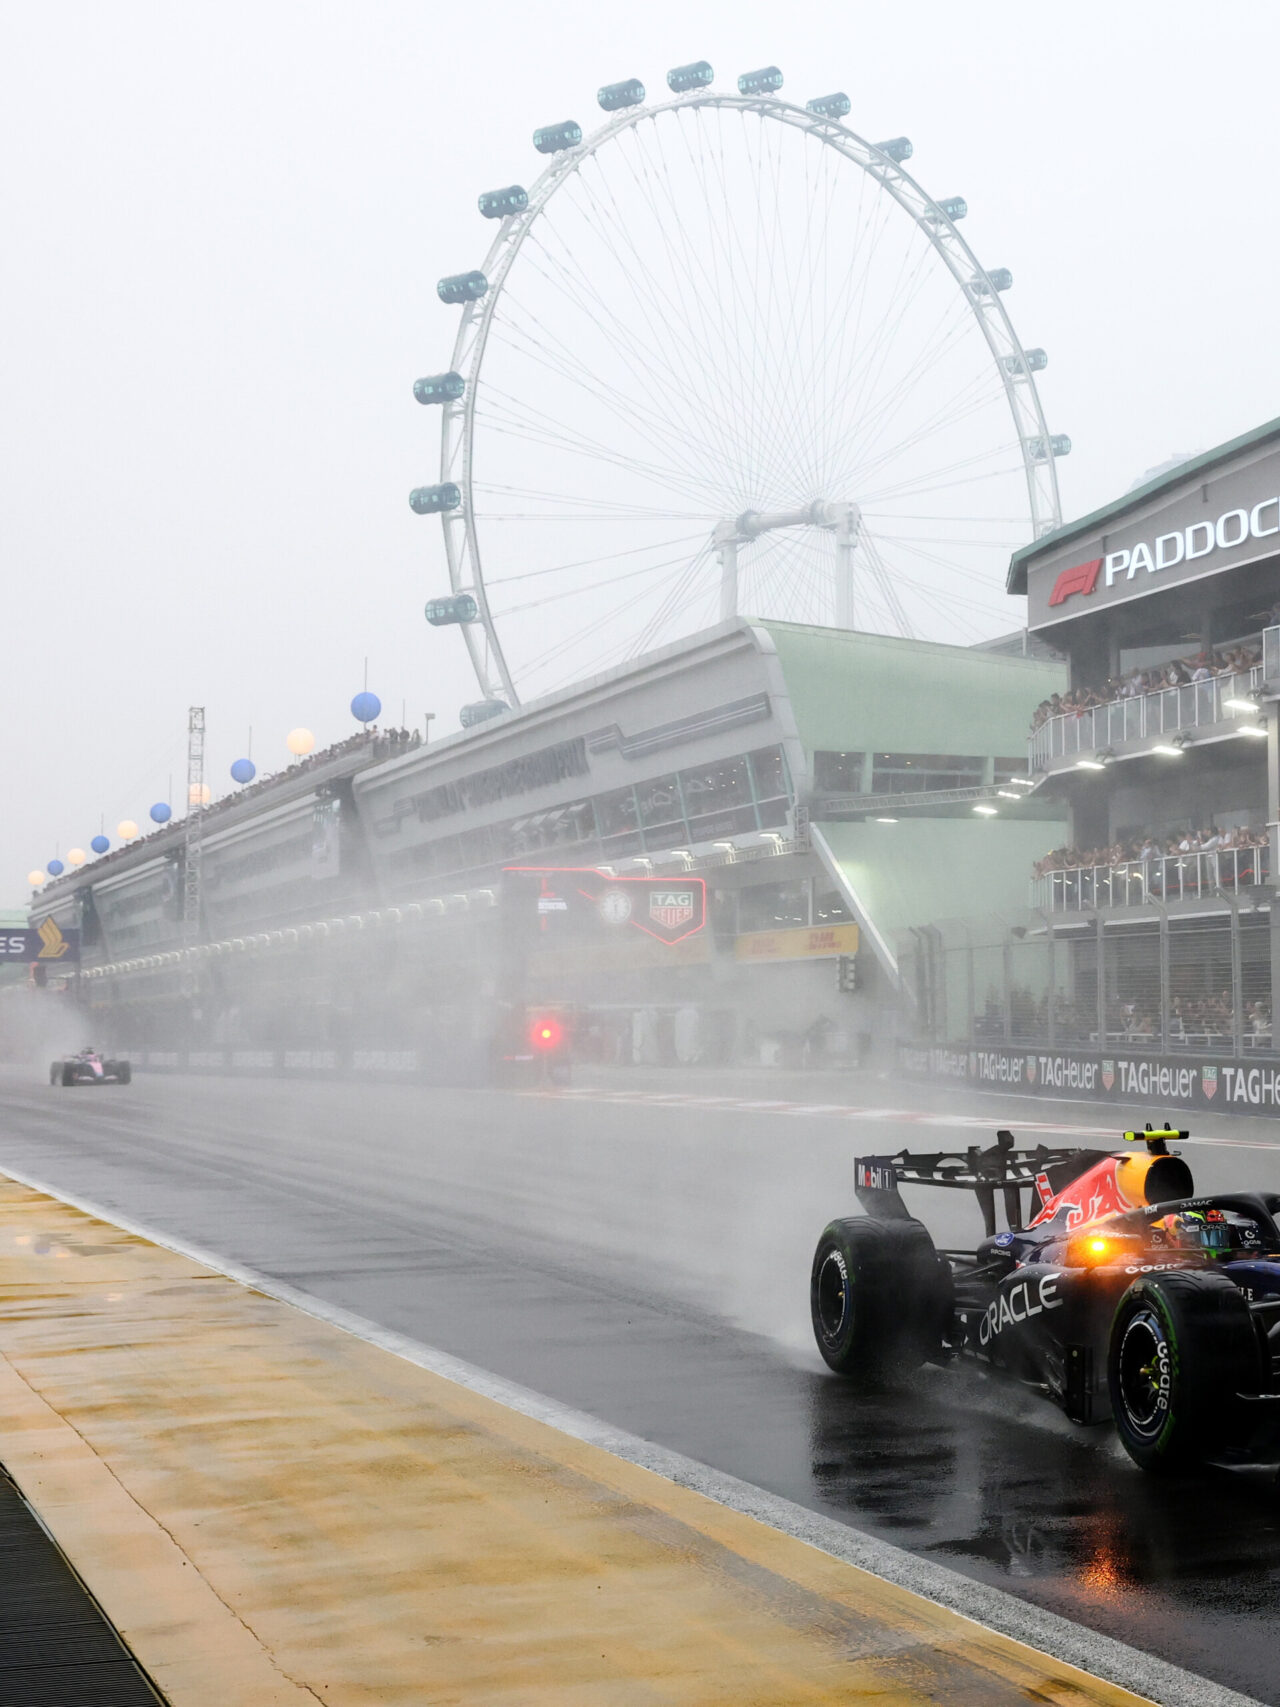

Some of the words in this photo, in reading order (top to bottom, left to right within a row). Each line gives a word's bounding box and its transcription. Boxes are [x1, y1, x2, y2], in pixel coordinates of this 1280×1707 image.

[1049, 558, 1103, 606] F1
[654, 894, 690, 906] TAG
[858, 1164, 882, 1188] Mobil
[979, 1272, 1064, 1346] ORACLE
